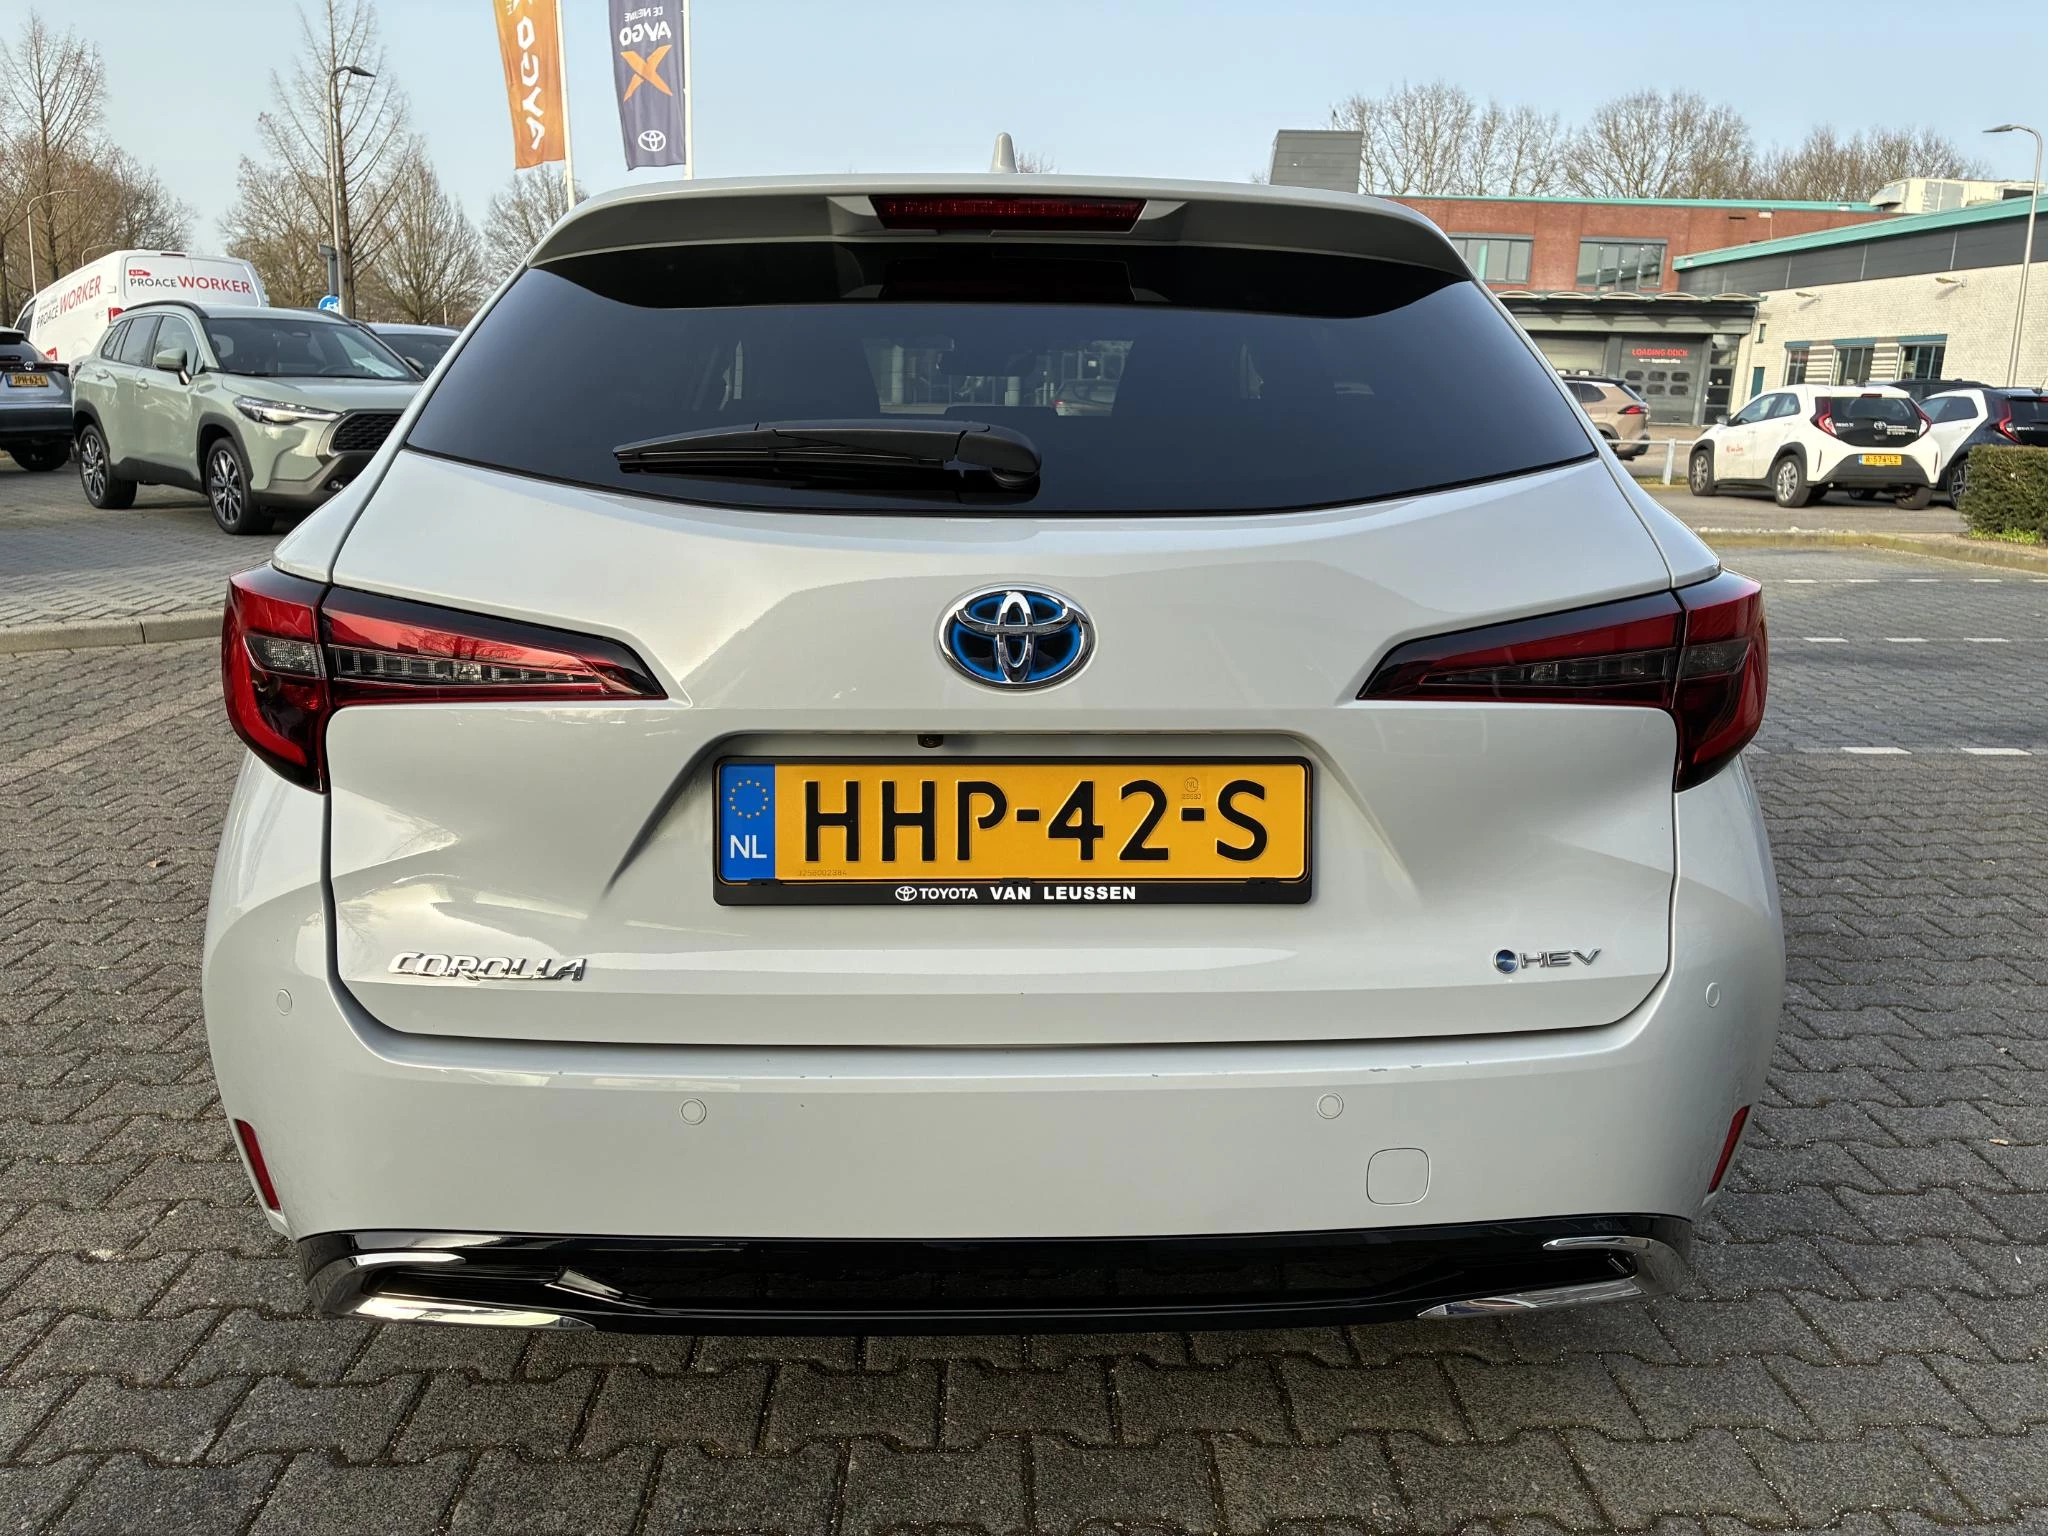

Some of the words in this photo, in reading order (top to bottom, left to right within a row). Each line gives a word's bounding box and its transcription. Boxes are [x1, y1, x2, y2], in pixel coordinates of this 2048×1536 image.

[130, 278, 177, 288] PROACE
[177, 276, 251, 294] WORKER
[36, 304, 59, 329] PROACE
[60, 275, 102, 316] WORKER
[804, 779, 1269, 862] HHP-42-S
[729, 834, 767, 860] NL
[919, 887, 978, 899] TOYOTA
[990, 886, 1031, 900] VAN
[1043, 886, 1136, 900] LEUSSEN
[387, 951, 588, 982] COROLLA
[1519, 948, 1602, 969] HEV
